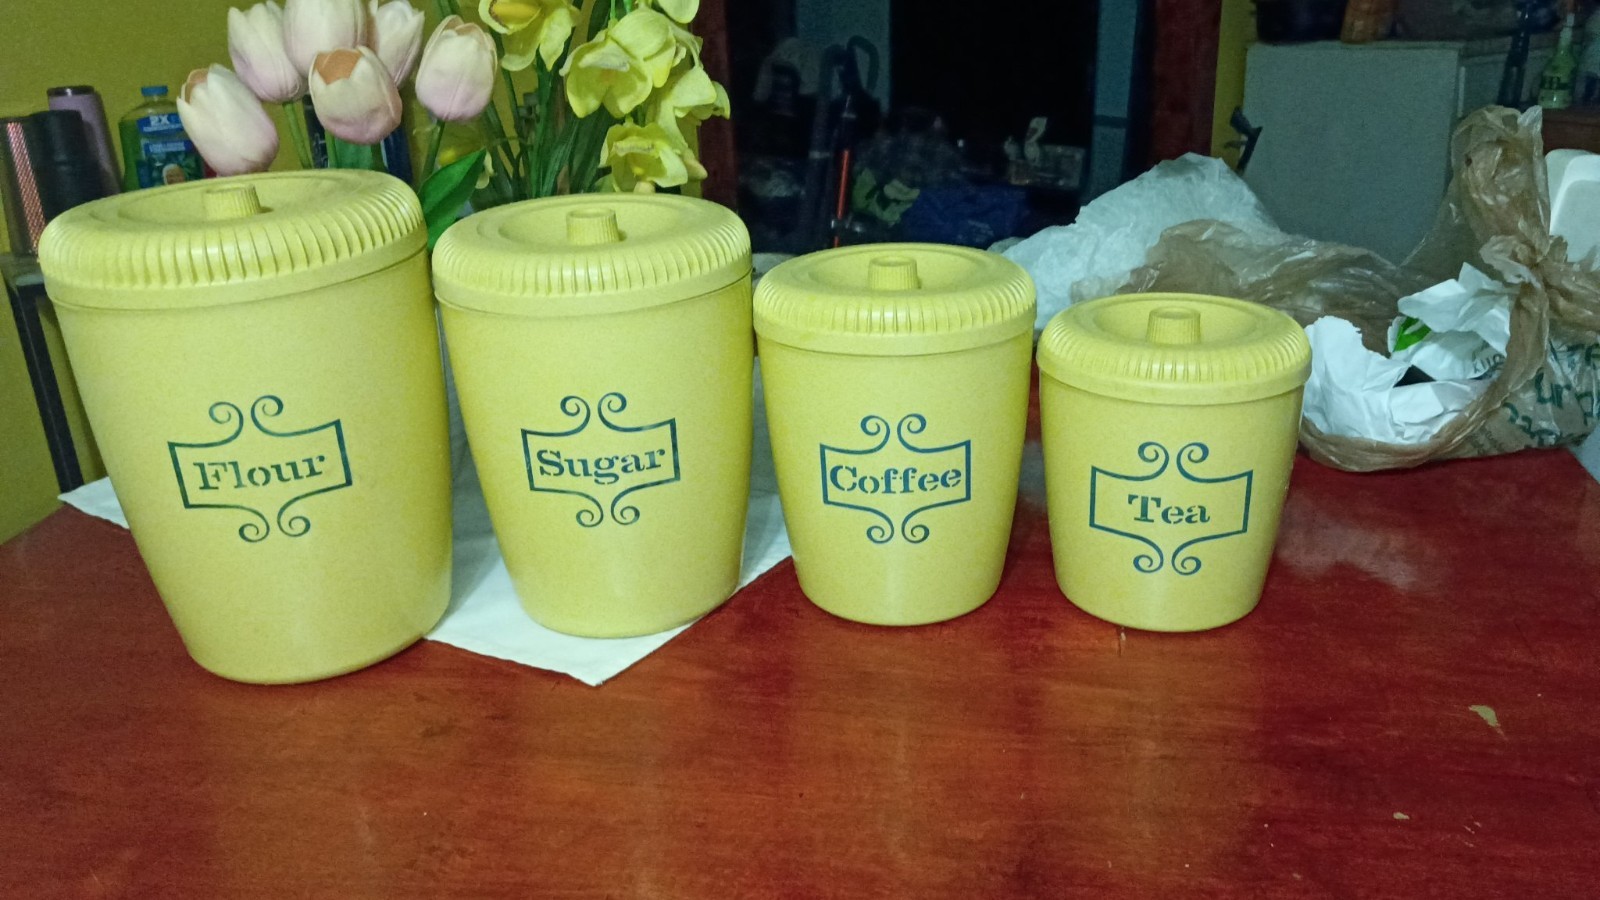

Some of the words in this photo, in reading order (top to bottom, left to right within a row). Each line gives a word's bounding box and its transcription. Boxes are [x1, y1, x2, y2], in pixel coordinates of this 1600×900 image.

[193, 455, 326, 491] Flour
[536, 448, 666, 485] Sugar
[829, 465, 962, 495] Coffee
[1127, 494, 1211, 525] Tea
